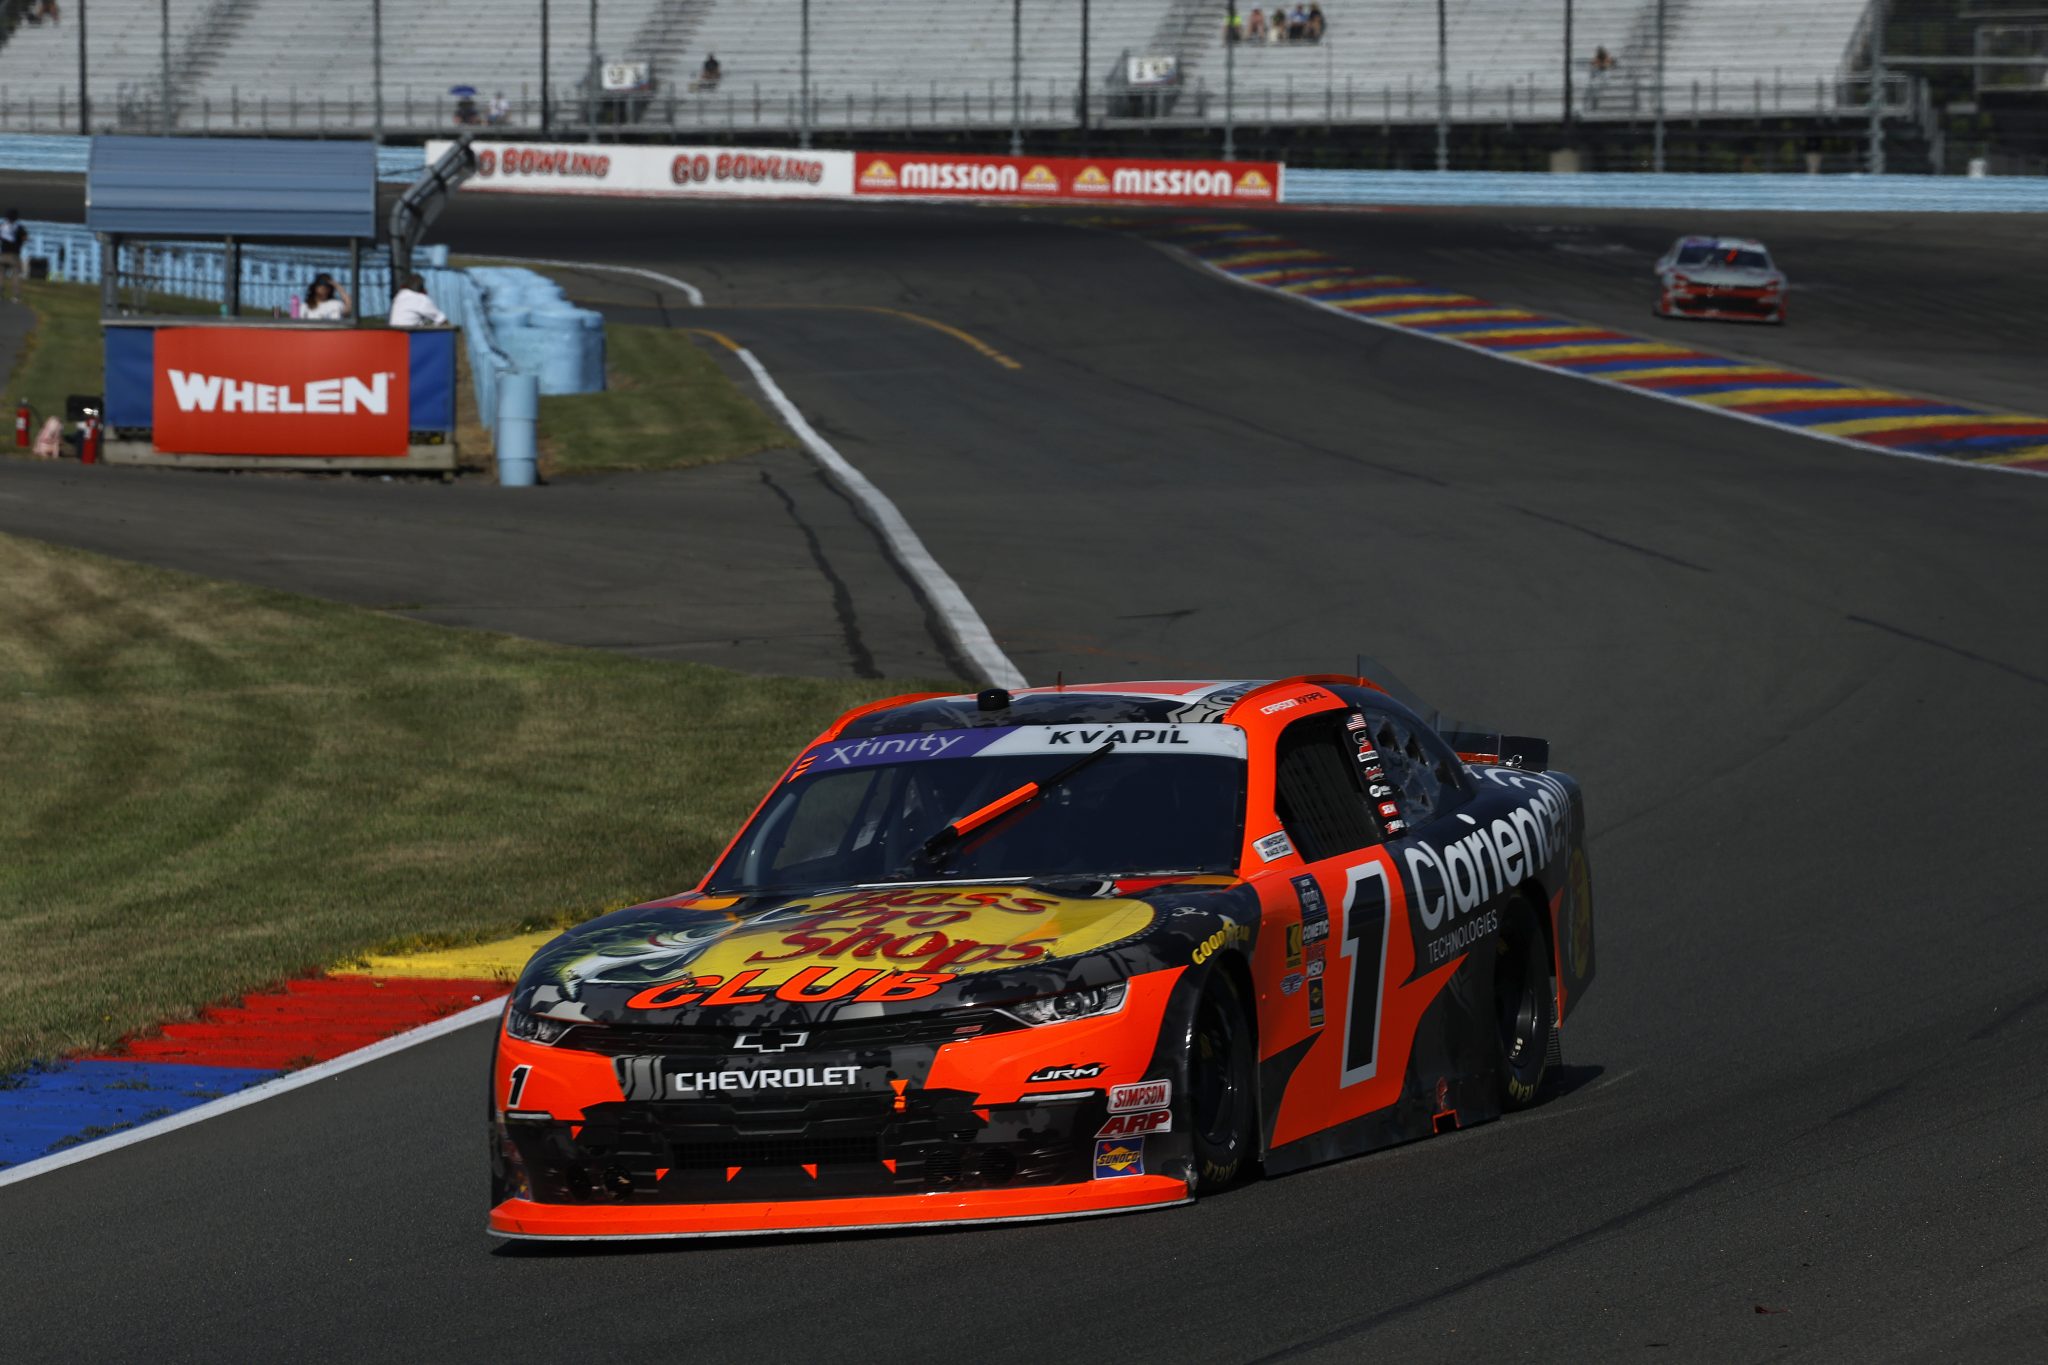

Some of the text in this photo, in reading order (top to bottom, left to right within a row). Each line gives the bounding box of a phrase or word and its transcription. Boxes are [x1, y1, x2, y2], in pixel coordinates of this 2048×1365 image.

[501, 148, 611, 178] BOWLING
[672, 154, 709, 184] GO
[714, 152, 824, 185] BOWLING
[901, 162, 1020, 192] MISSION
[1112, 166, 1233, 198] MISSION
[167, 368, 389, 415] WHELEN
[824, 733, 965, 766] xfinity
[1049, 729, 1190, 746] KVAPIL
[808, 890, 1060, 915] Bass
[794, 907, 973, 931] Pro
[744, 929, 1060, 973] Shops
[1427, 908, 1498, 964] TECHNOLOGIES
[626, 965, 958, 1010] CLUB
[1339, 860, 1393, 1090] 1
[507, 1064, 533, 1109] 1
[675, 1066, 862, 1092] CHEVROLET
[1030, 1066, 1100, 1081] JRM
[1114, 1085, 1166, 1108] SIMPSON
[1098, 1111, 1170, 1134] ARP
[1098, 1152, 1139, 1165] SUNOCO
